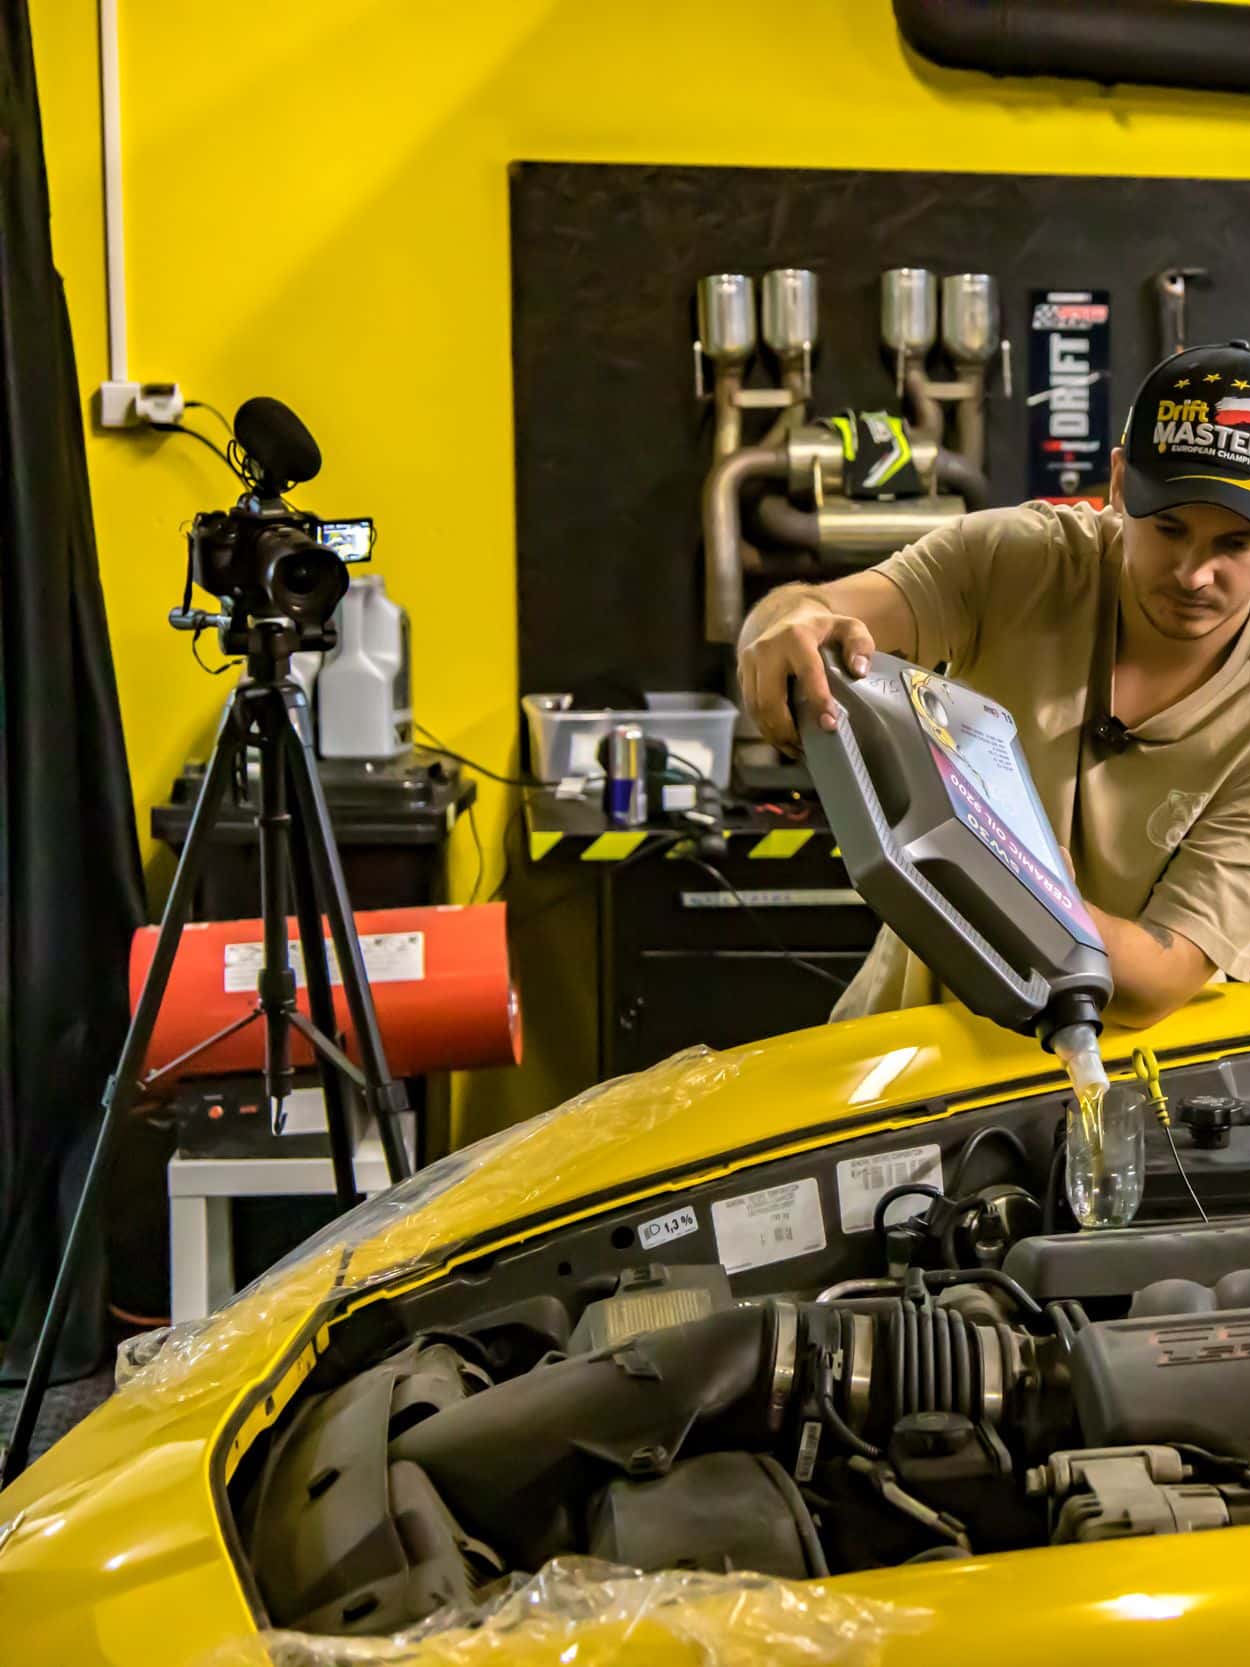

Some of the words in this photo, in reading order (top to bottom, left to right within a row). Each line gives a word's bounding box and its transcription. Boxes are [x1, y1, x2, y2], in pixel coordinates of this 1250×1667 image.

[1049, 333, 1090, 437] DRIFT
[1157, 400, 1210, 423] Drift
[1171, 444, 1216, 456] EUROPEAN
[967, 814, 1020, 874] 5W30
[985, 813, 1006, 841] OIL
[1008, 841, 1073, 909] CERAMIC
